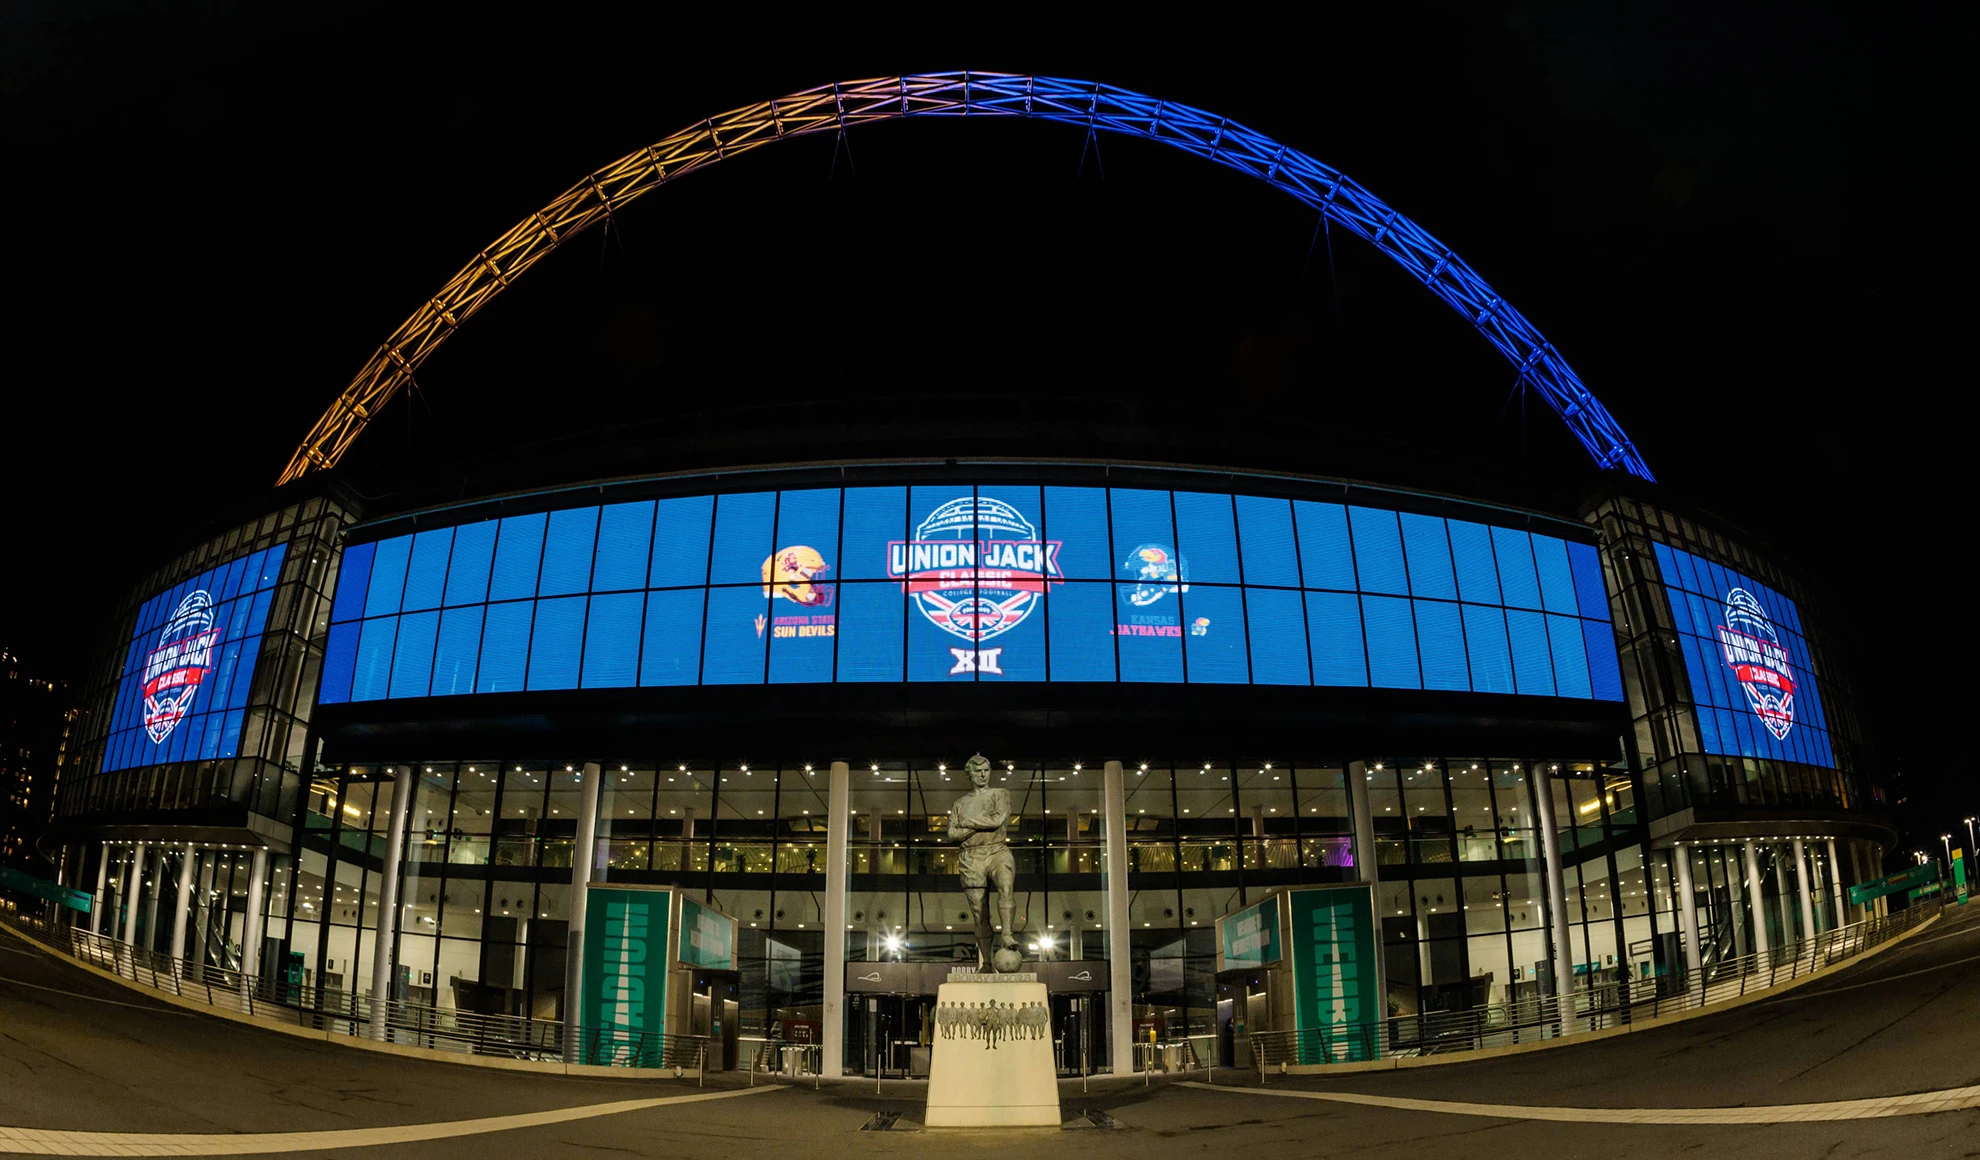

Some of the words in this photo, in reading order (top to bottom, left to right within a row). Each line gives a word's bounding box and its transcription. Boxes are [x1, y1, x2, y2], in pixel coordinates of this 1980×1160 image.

[892, 544, 977, 574] UNION
[985, 544, 1057, 574] JACK
[939, 571, 1012, 588] CLASSIC
[979, 589, 1013, 597] FOOTBALL
[774, 616, 809, 625] ARIZONA
[1131, 615, 1175, 625] KANSAS
[773, 626, 796, 638] SUN
[798, 625, 835, 637] DEVILS
[1109, 624, 1182, 637] JAYHAWKS
[1720, 630, 1763, 664] UNION
[950, 648, 1003, 675] XII
[600, 903, 649, 1067] STADIUM
[1312, 903, 1361, 1063] WEMBLE
